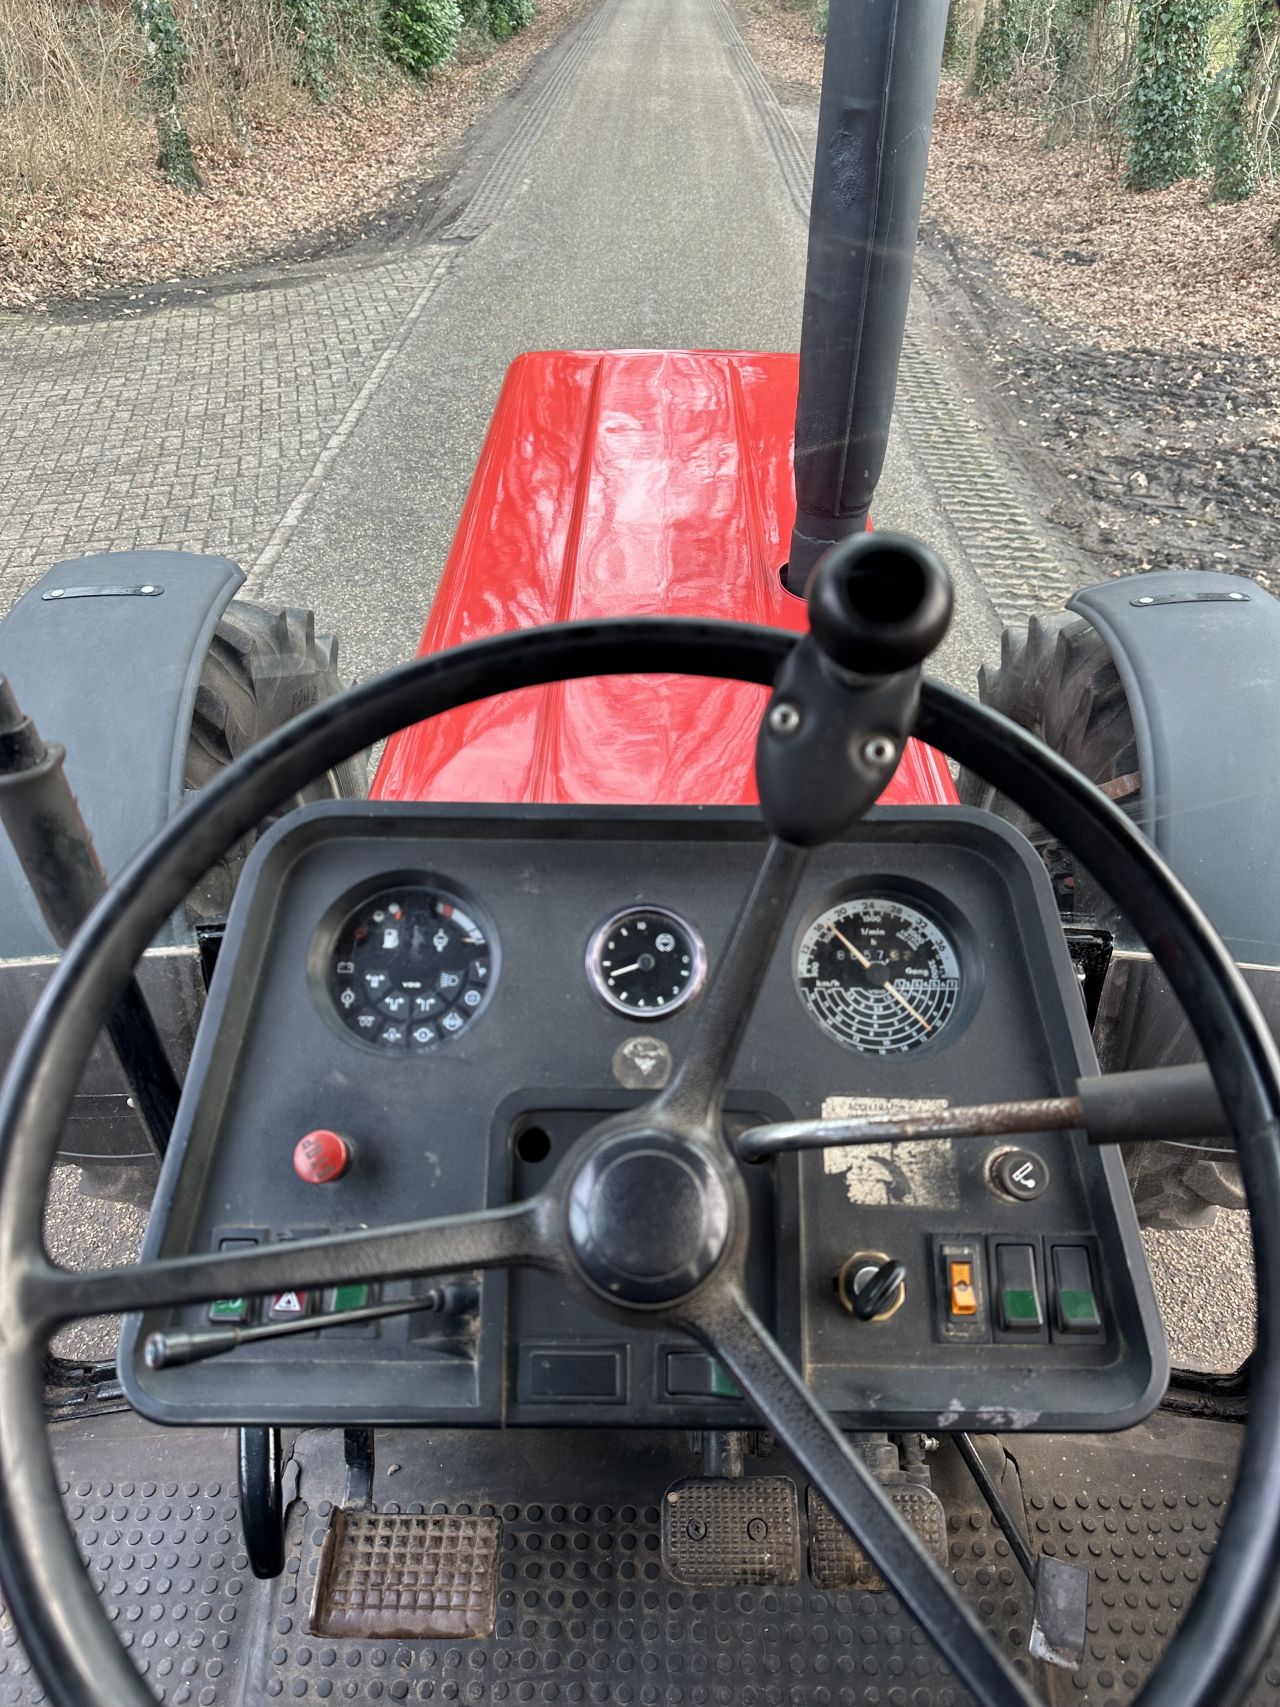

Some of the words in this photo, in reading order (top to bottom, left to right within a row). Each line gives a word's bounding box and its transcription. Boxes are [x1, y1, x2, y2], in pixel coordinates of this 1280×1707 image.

[862, 902, 875, 910] 24
[890, 905, 902, 914] 28
[834, 907, 847, 917] 20
[637, 921, 647, 930] 10
[915, 919, 928, 929] 32
[801, 944, 810, 954] 12
[935, 939, 946, 952] 36
[682, 955, 689, 963] 0
[673, 986, 679, 994] 2
[302, 1139, 338, 1179] STOP
